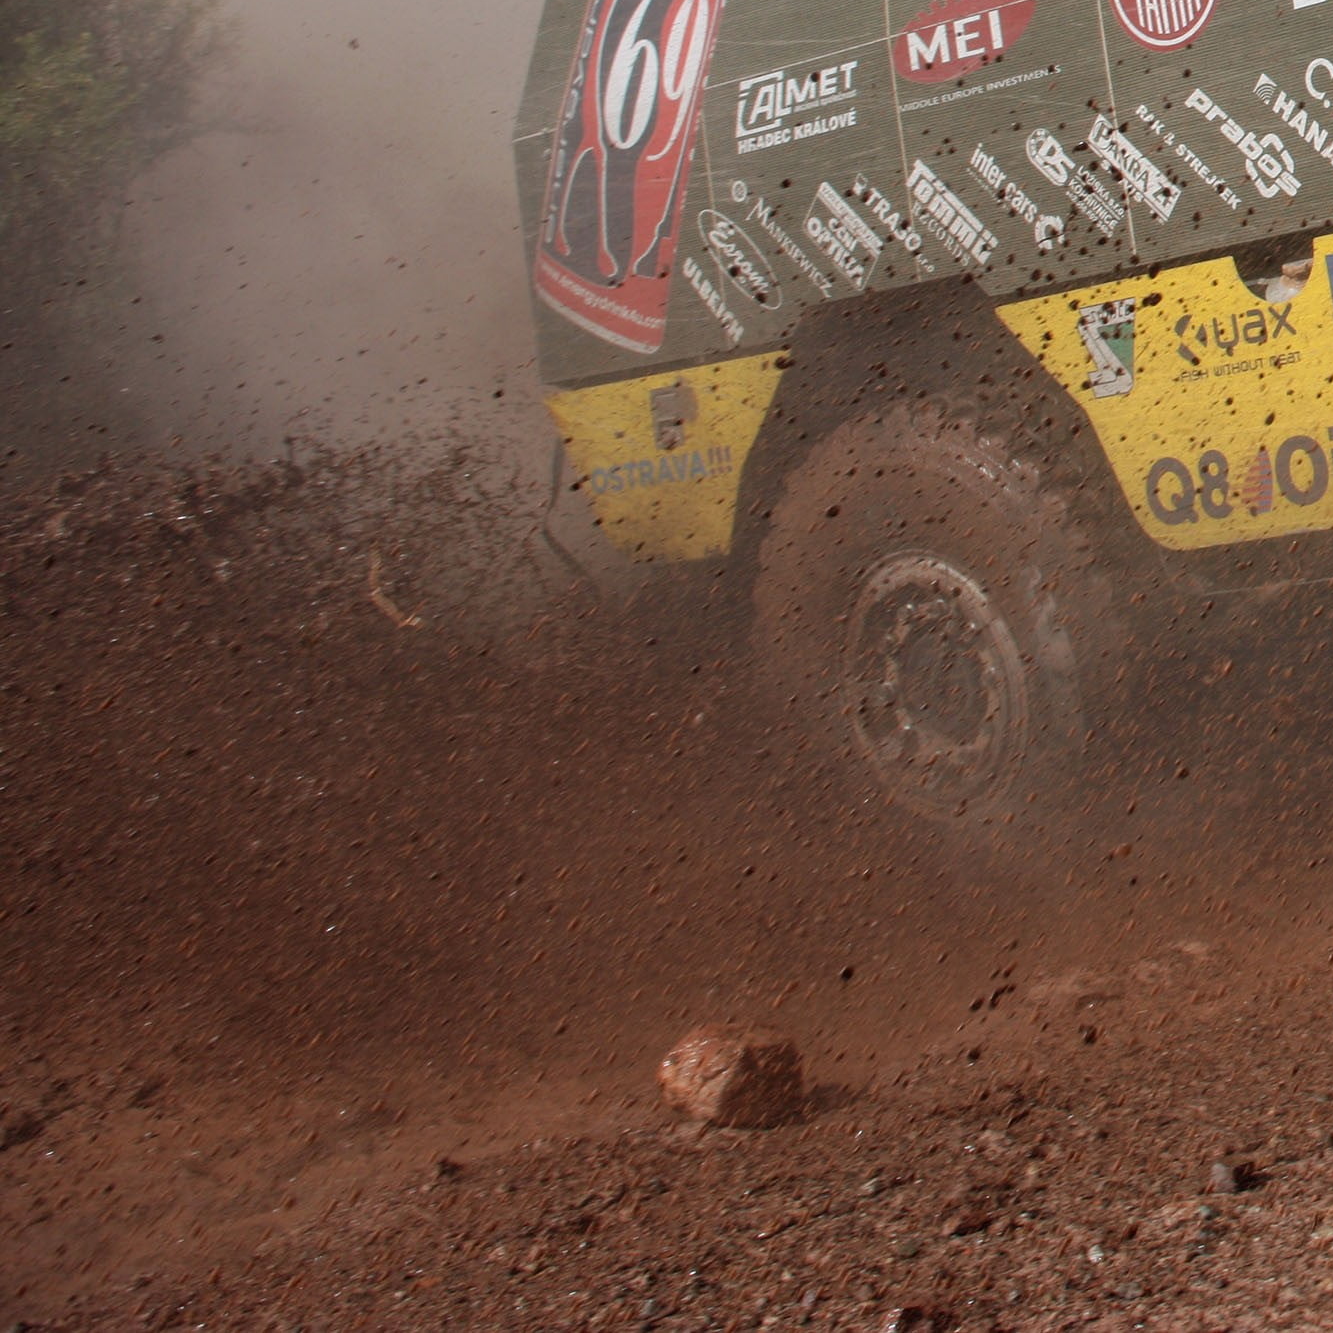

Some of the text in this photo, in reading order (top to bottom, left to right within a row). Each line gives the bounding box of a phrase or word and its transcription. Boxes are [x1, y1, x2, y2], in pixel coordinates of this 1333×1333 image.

[906, 9, 1003, 71] MEI
[941, 85, 983, 103] EUROPE
[986, 64, 1062, 92] INVESTMENS
[1136, 105, 1165, 134] RAK
[970, 142, 1007, 189] inter
[1004, 181, 1038, 223] cars
[1145, 451, 1233, 525] Q8
